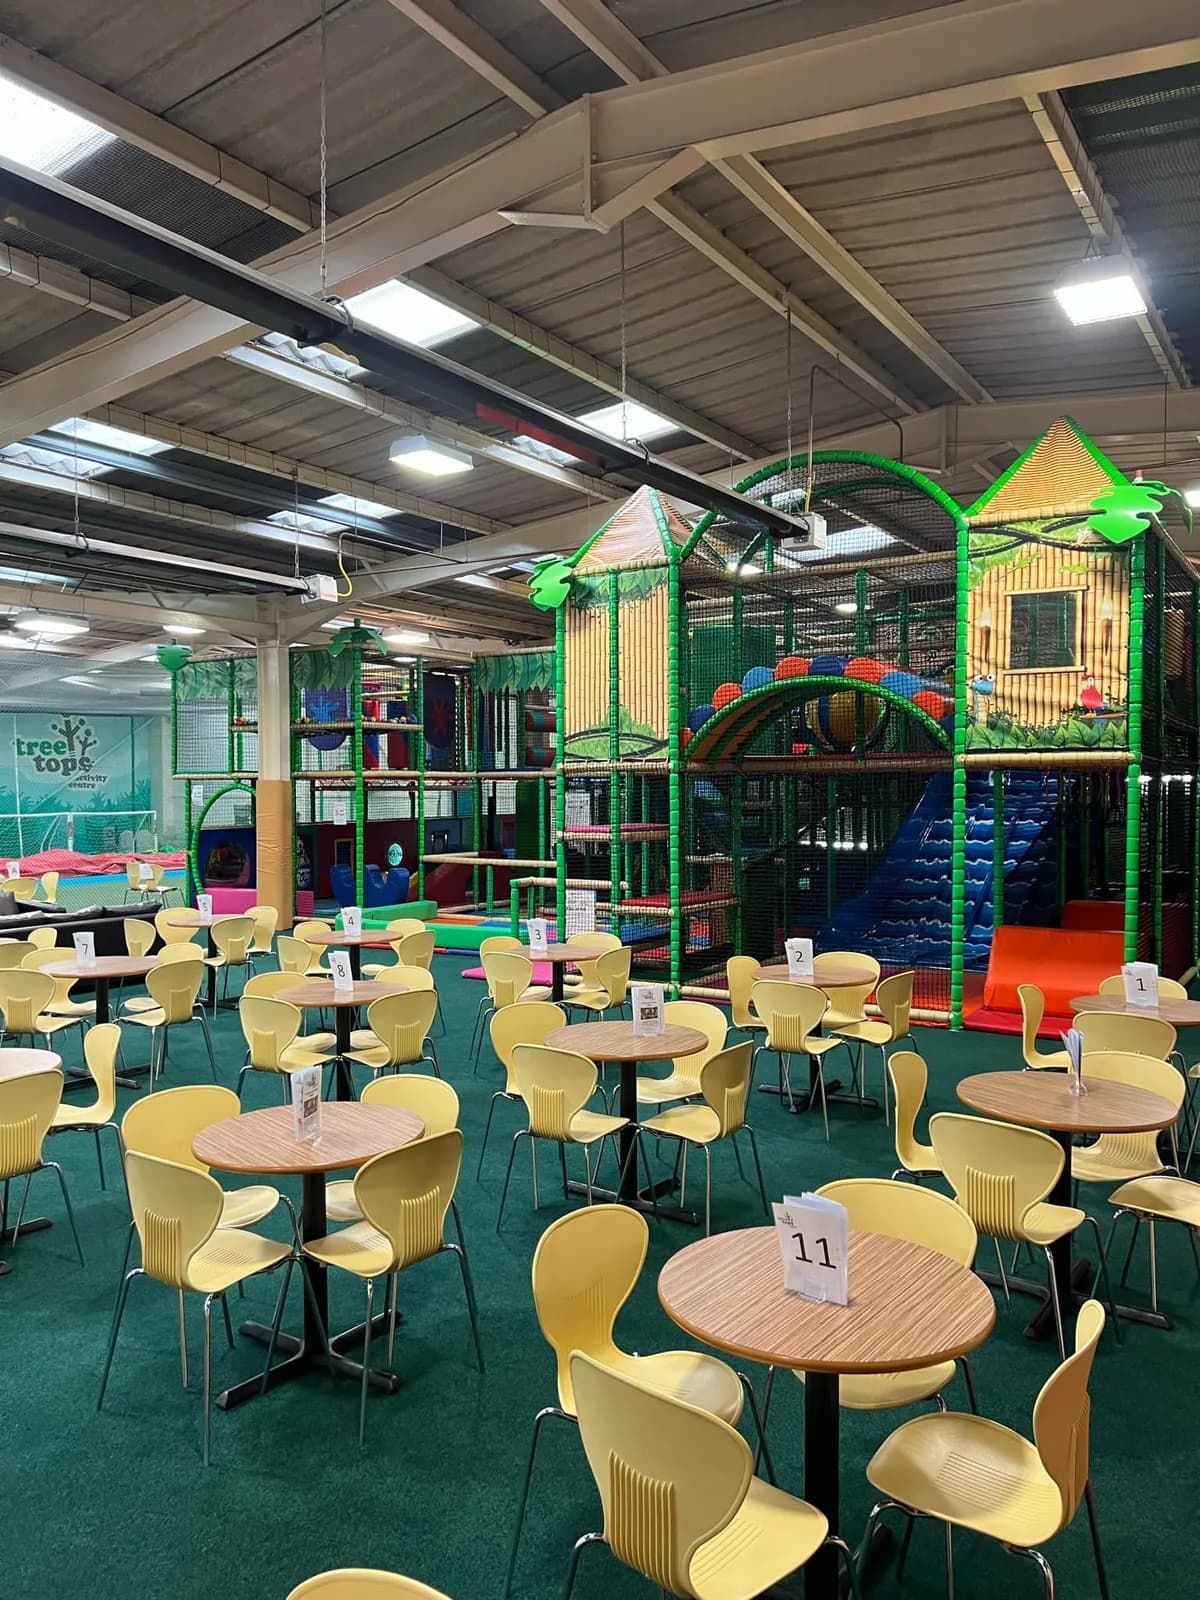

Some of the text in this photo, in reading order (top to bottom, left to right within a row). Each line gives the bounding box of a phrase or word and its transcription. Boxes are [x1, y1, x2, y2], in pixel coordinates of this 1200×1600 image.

[16, 738, 67, 756] tree
[33, 755, 95, 776] tops
[348, 916, 355, 927] 4
[535, 928, 542, 941] 3
[82, 943, 89, 956] 7
[795, 950, 804, 962] 2
[337, 964, 345, 977] 8
[1136, 978, 1147, 991] 1
[792, 1232, 837, 1270] 11
